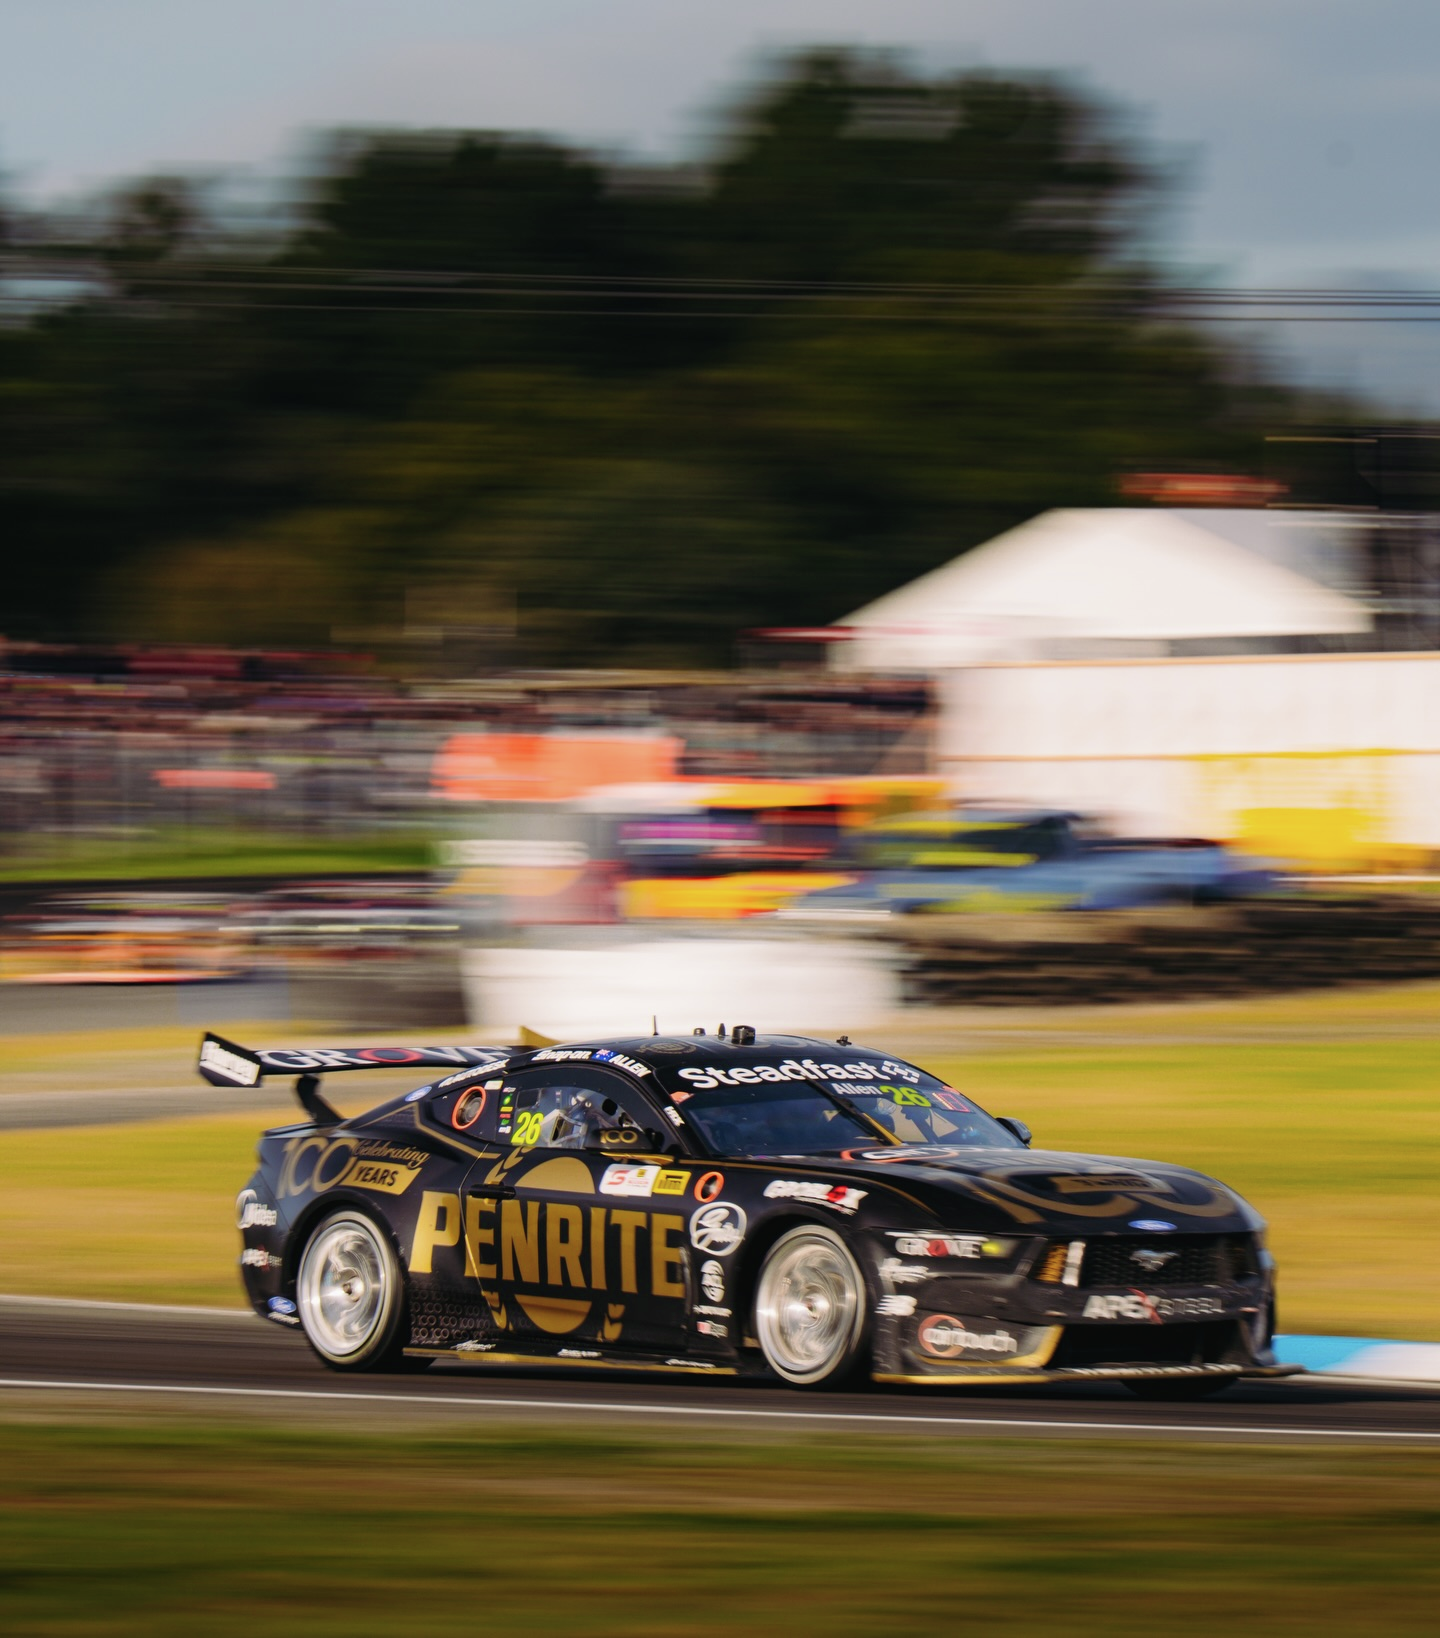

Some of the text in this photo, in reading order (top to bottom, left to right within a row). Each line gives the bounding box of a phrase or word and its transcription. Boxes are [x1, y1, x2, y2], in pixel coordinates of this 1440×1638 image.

[255, 1046, 513, 1068] GROVE
[531, 1049, 592, 1062] Snap-on
[608, 1054, 652, 1078] ALLEN
[678, 1059, 891, 1089] Steadfast
[831, 1083, 931, 1107] Allen 26
[511, 1112, 544, 1145] 26
[351, 1139, 430, 1169] Celebrating
[276, 1136, 361, 1199] 100
[353, 1165, 399, 1187] YEARS
[407, 1190, 686, 1299] PENRITE
[895, 1238, 981, 1259] GROVE
